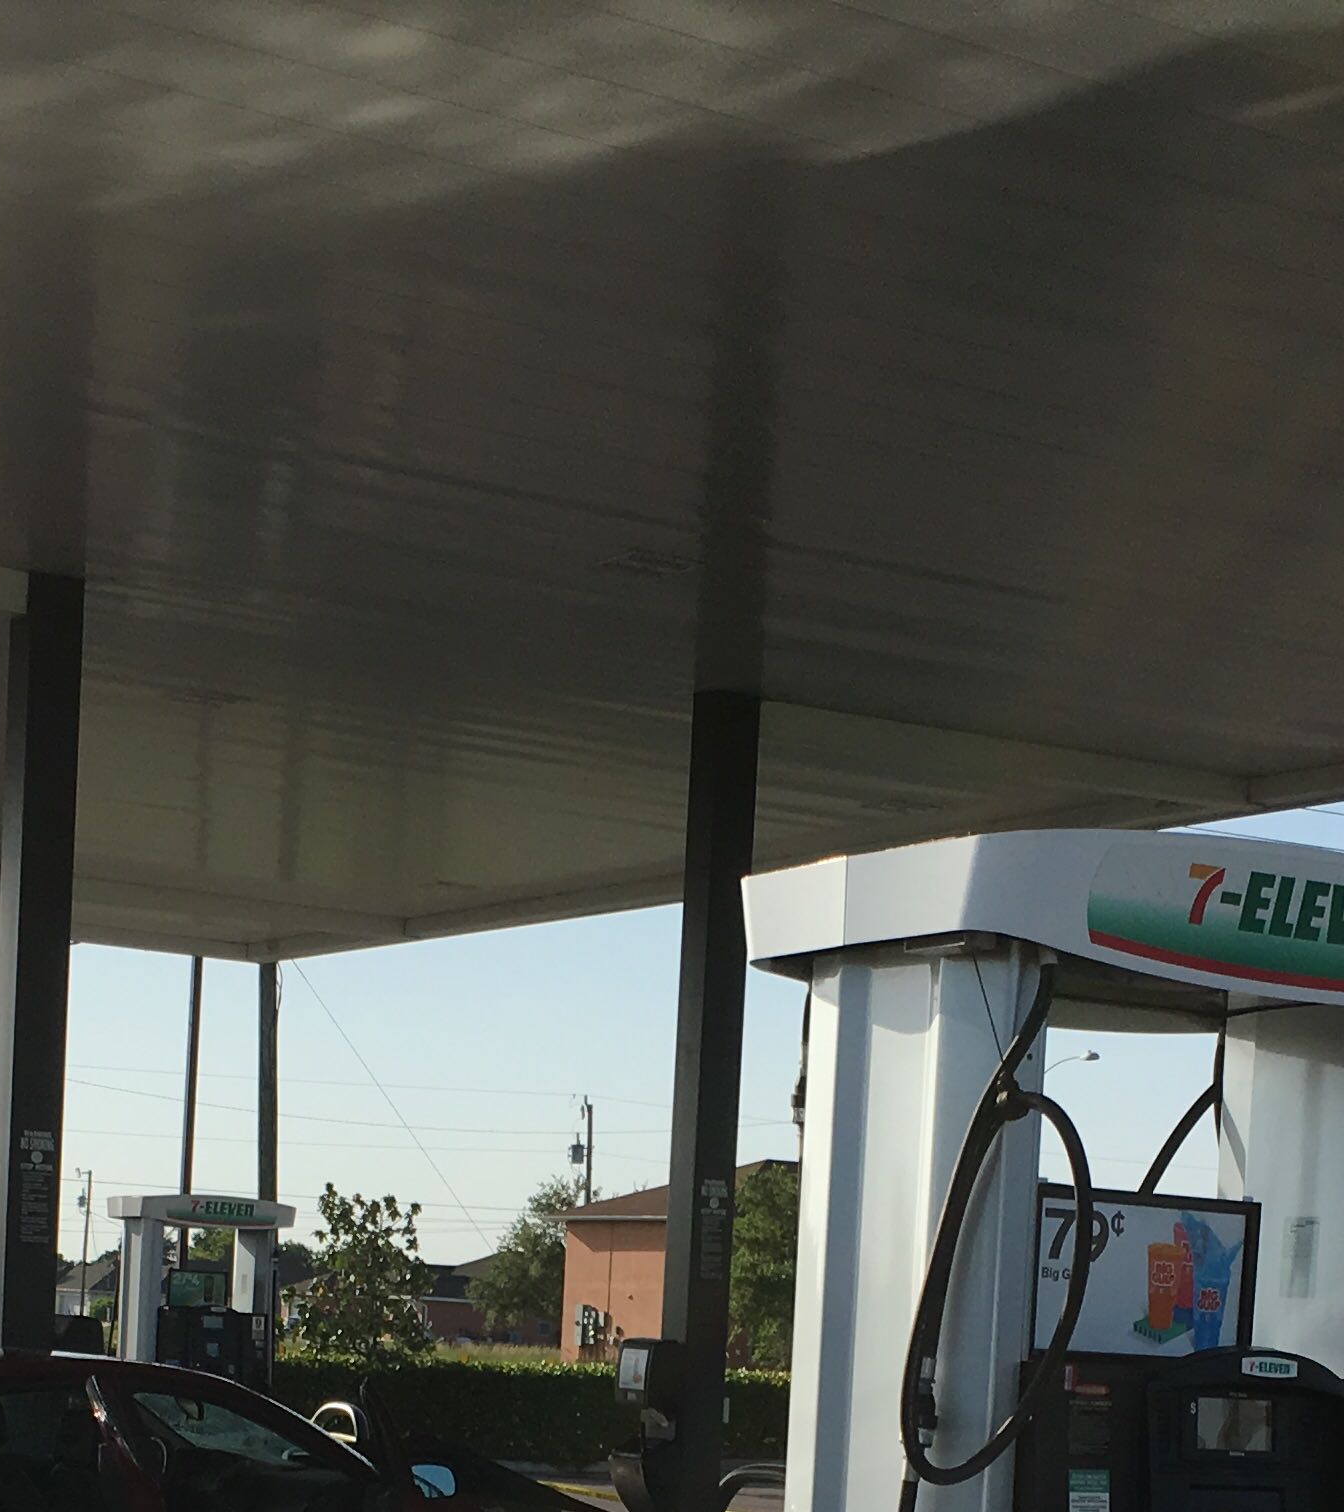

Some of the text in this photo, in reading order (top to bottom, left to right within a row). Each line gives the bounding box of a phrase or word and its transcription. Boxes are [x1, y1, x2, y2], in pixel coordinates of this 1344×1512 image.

[191, 1200, 255, 1217] 7-ELEVEN
[1041, 1266, 1059, 1281] Big
[1249, 1361, 1290, 1374] 7-ELEVEN
